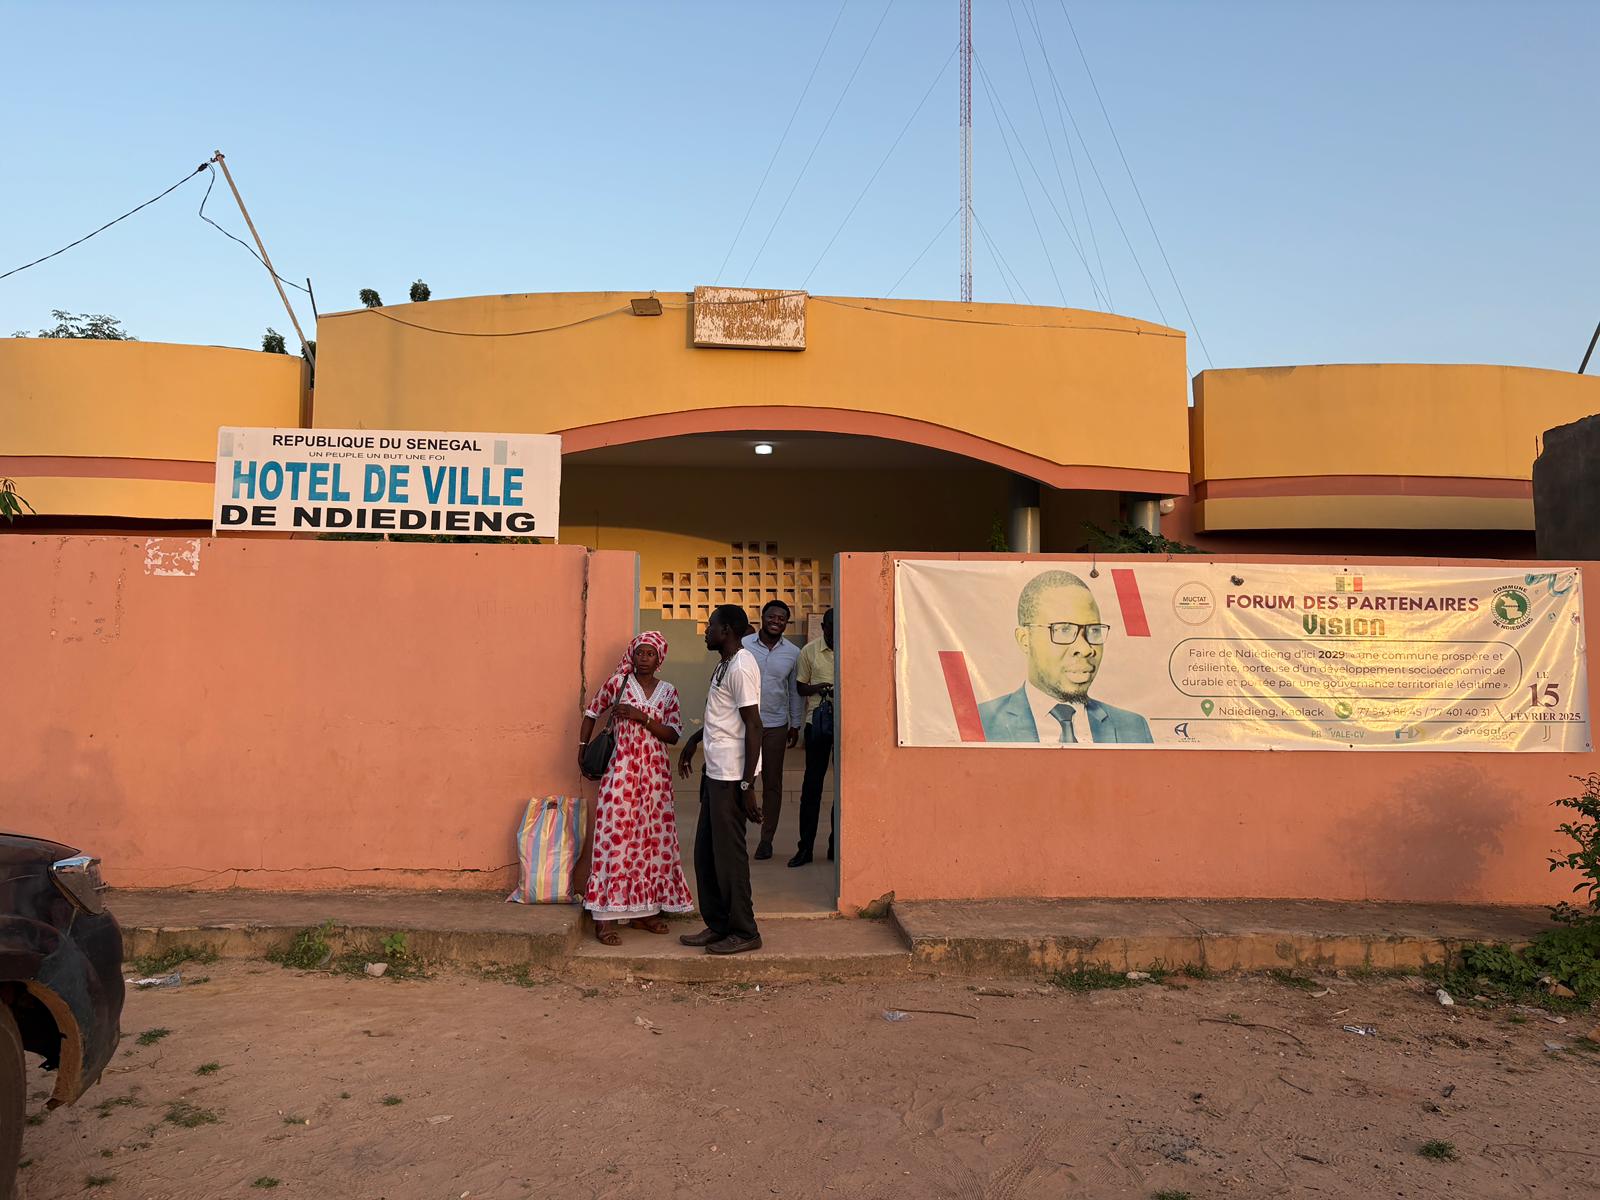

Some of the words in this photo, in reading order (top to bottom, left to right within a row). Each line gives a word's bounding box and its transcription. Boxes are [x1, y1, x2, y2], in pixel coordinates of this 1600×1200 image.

[272, 434, 374, 449] REPUBLIQUE
[380, 437, 402, 449] DU
[406, 438, 482, 452] SENEGAL
[232, 460, 350, 502] HOTEL
[363, 464, 410, 503] DE
[422, 465, 524, 506] VILLE
[220, 505, 276, 526] DE
[293, 506, 535, 533] NDIEDIENG
[1492, 584, 1528, 594] COMMUNE
[1226, 594, 1295, 609] FORUM
[1303, 596, 1339, 610] DES
[1347, 596, 1480, 612] PARTENAIRES
[1189, 649, 1216, 658] Faire
[1218, 649, 1232, 658] de
[1359, 652, 1379, 660] une
[1382, 653, 1439, 661] commune
[1442, 651, 1489, 662] prospère
[1188, 663, 1239, 673] résiliente,
[1320, 664, 1405, 676] développement
[1536, 671, 1549, 679] LE
[1182, 677, 1223, 687] durable
[1226, 679, 1237, 687] et
[1279, 680, 1296, 689] par
[1323, 680, 1395, 690] gouvernance
[1397, 680, 1454, 689] territoriale
[1456, 680, 1501, 690] légitime
[1528, 683, 1560, 708] 15
[1281, 706, 1325, 717] Kaolack
[1446, 708, 1463, 717] 401
[1465, 708, 1478, 717] 40
[1480, 708, 1490, 717] 31
[1559, 712, 1581, 721] 2025
